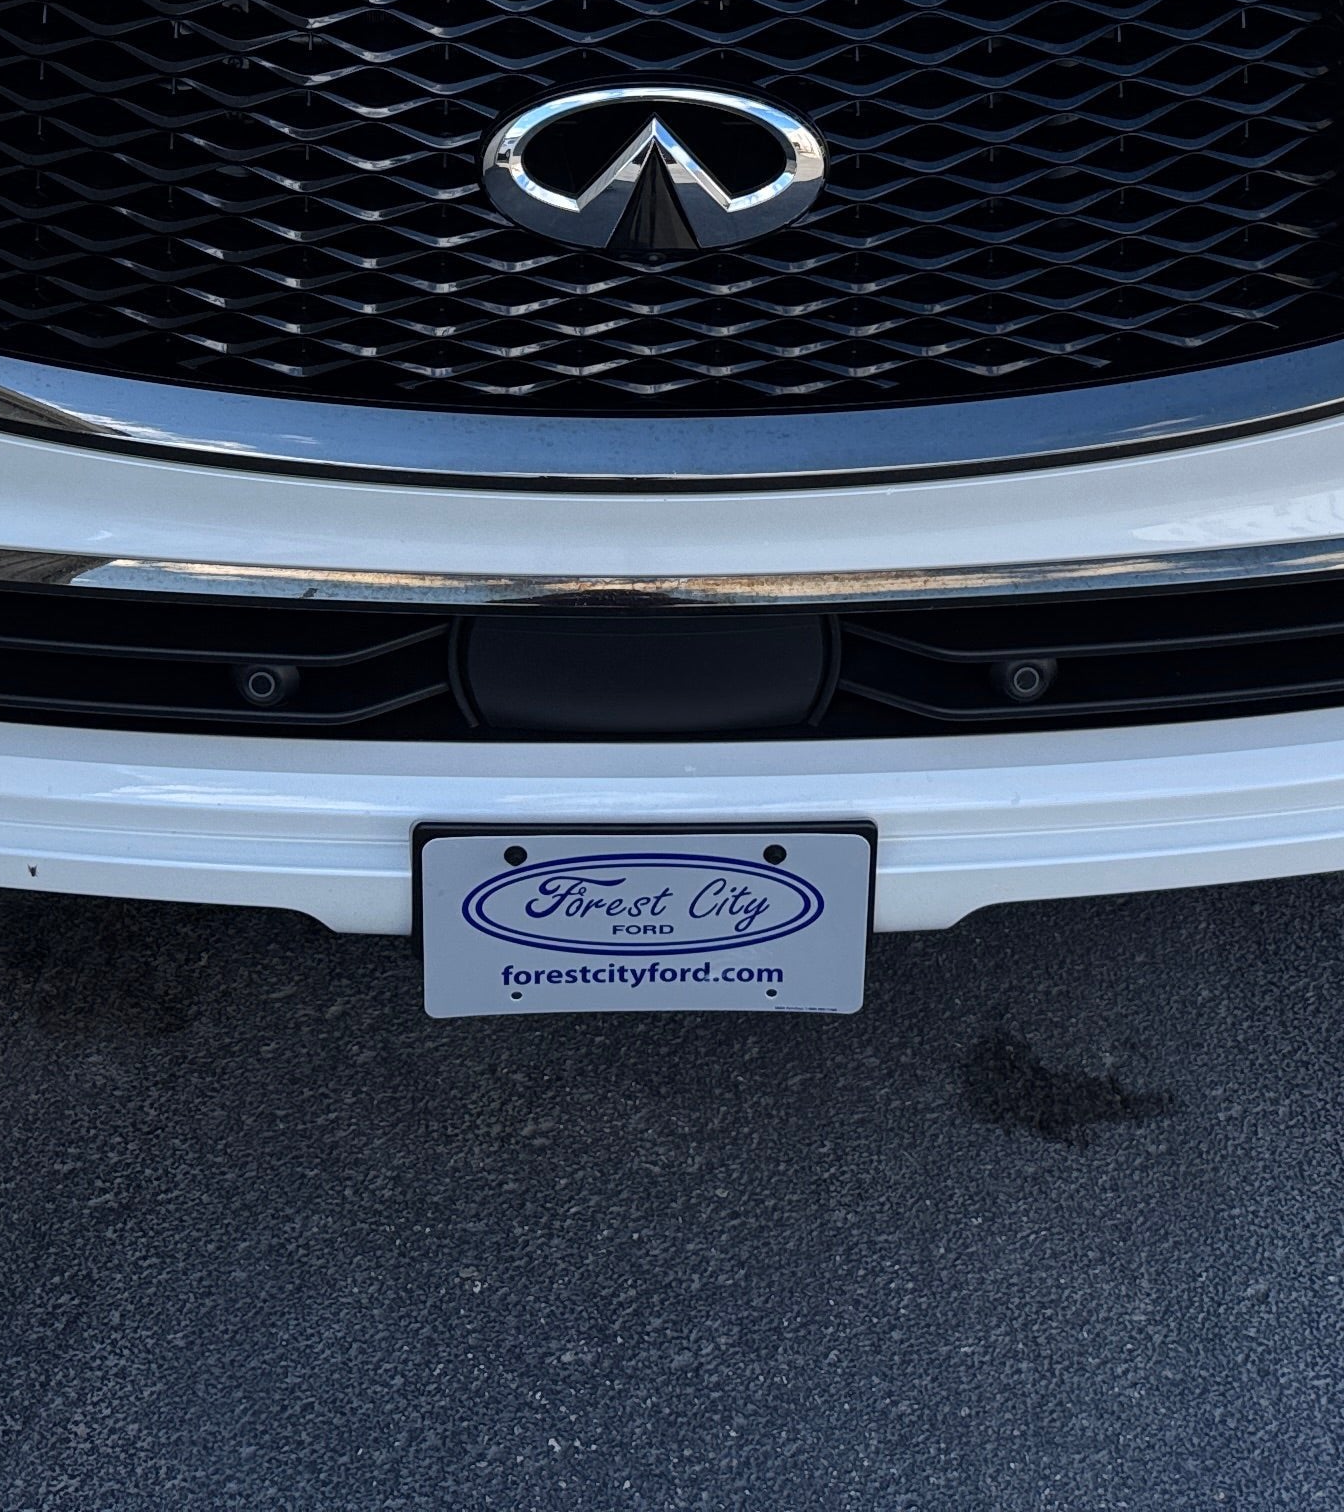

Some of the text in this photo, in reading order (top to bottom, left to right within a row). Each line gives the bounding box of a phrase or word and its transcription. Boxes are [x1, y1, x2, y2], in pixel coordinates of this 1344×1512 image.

[524, 875, 771, 932] Forest City
[611, 924, 675, 935] FORD
[501, 962, 784, 988] forestcityford.com
